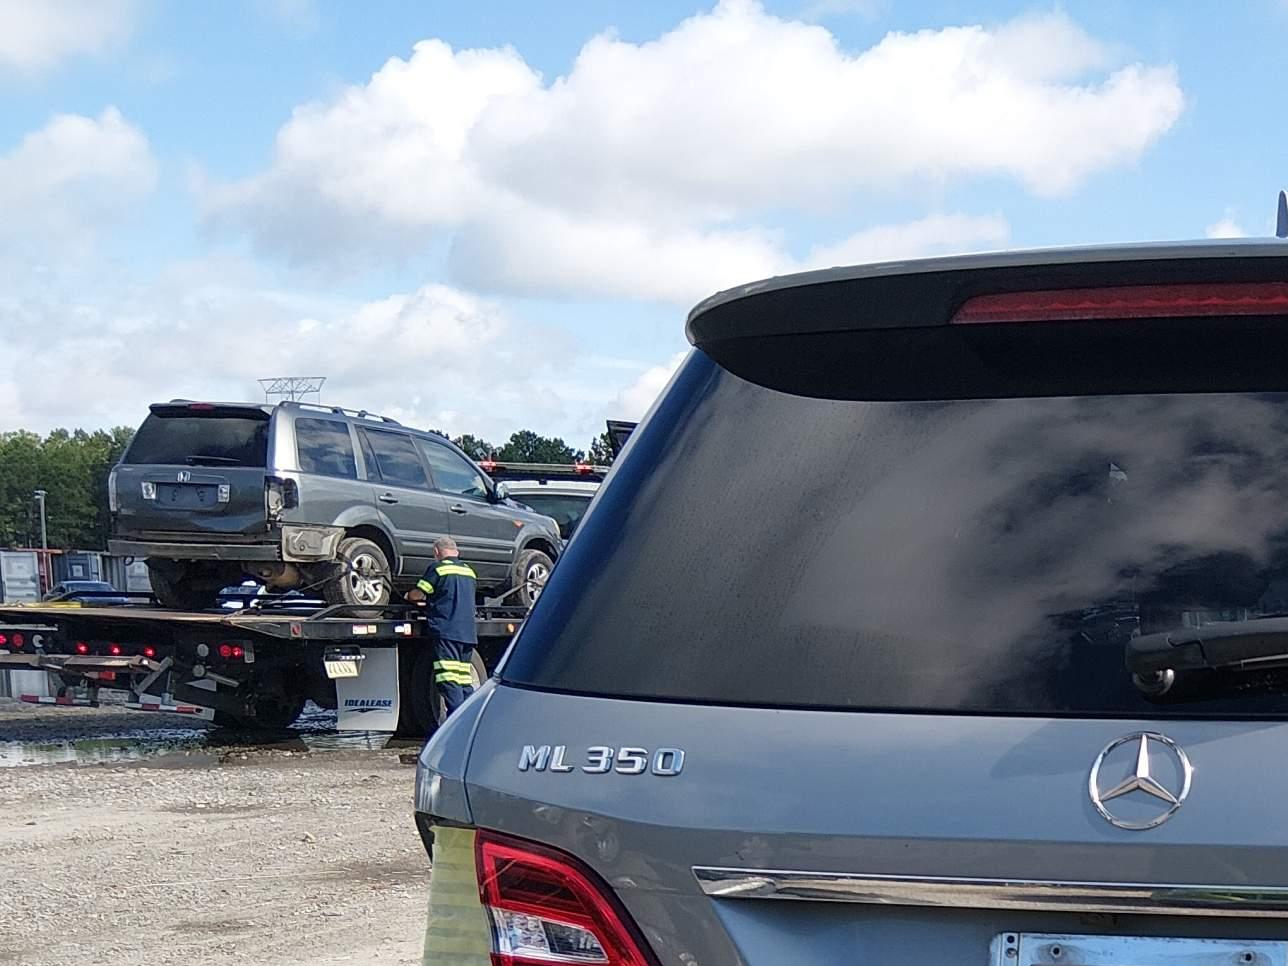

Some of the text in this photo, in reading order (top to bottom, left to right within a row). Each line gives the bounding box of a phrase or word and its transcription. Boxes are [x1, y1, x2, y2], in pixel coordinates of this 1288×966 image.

[344, 699, 392, 707] IDEALEASE
[518, 744, 685, 776] ML 350
